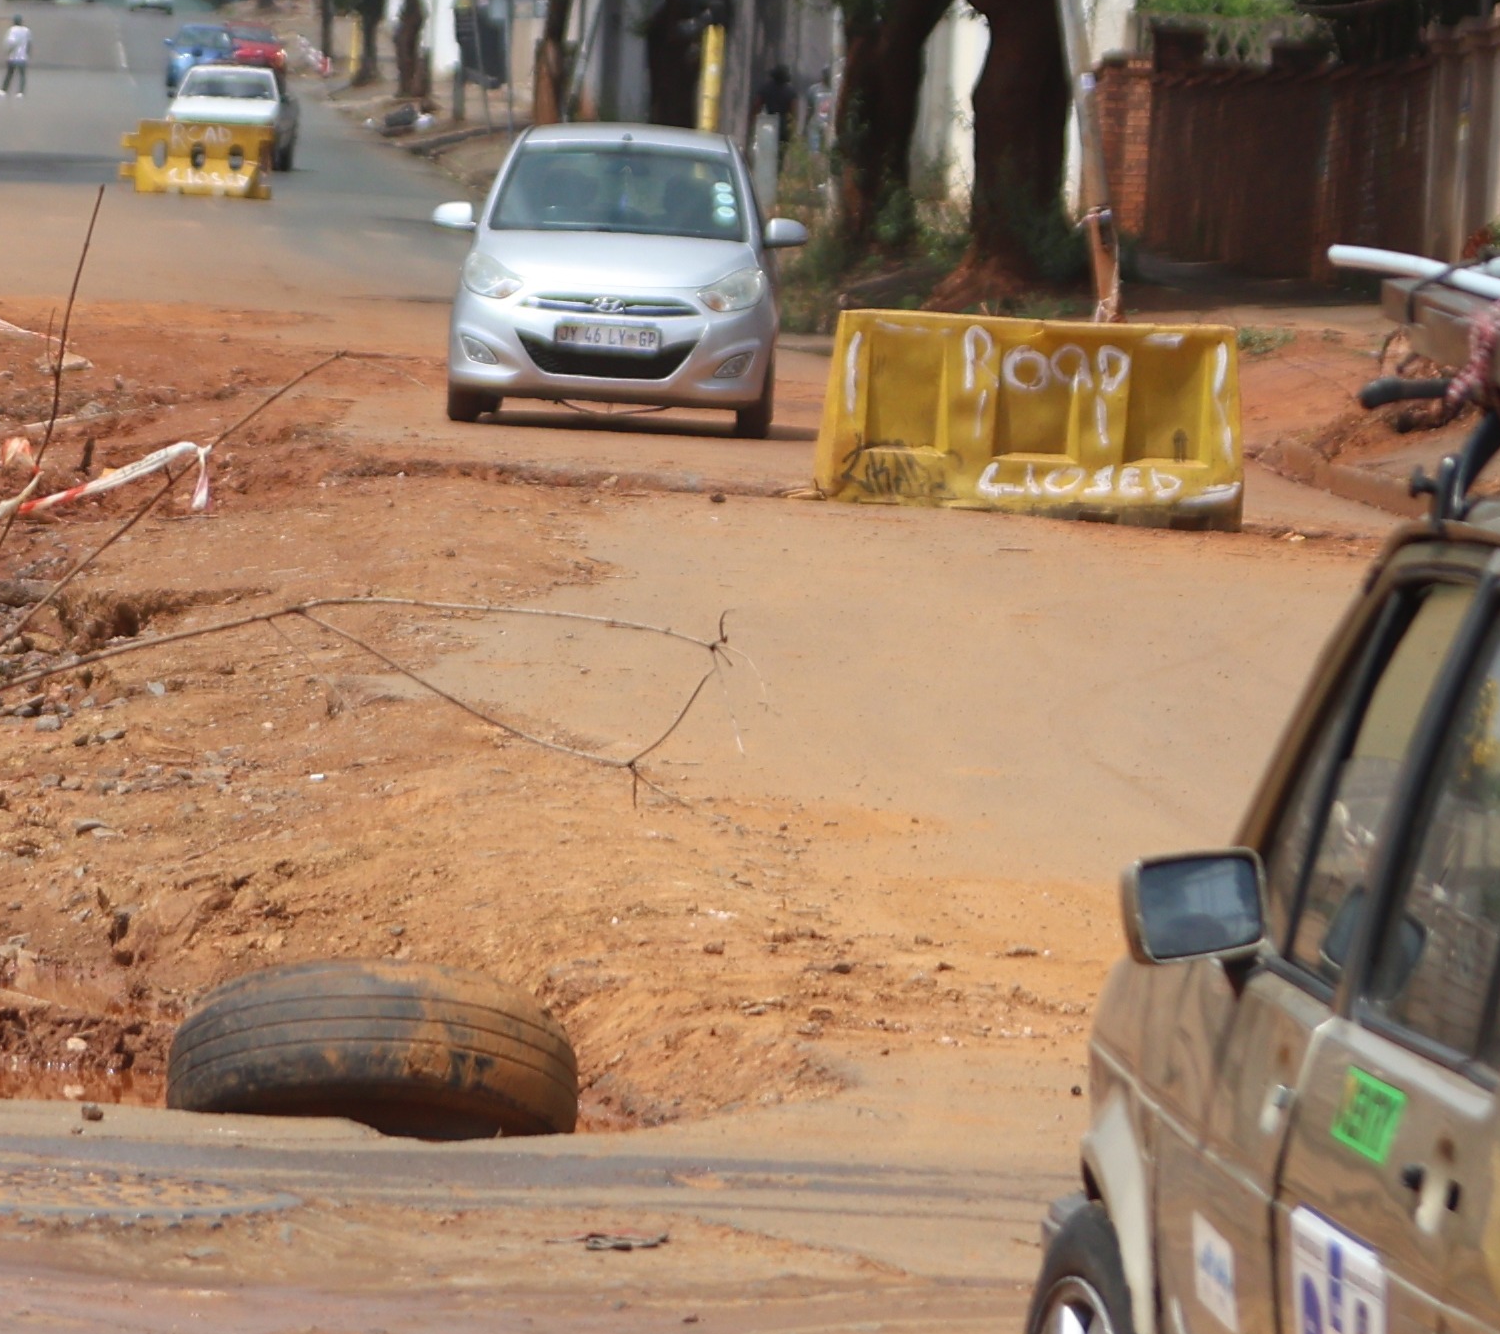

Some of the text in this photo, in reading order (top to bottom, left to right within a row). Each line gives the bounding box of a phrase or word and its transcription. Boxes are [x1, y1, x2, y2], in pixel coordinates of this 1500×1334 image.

[585, 328, 602, 343] 46
[608, 329, 626, 344] LY
[639, 331, 657, 347] GP
